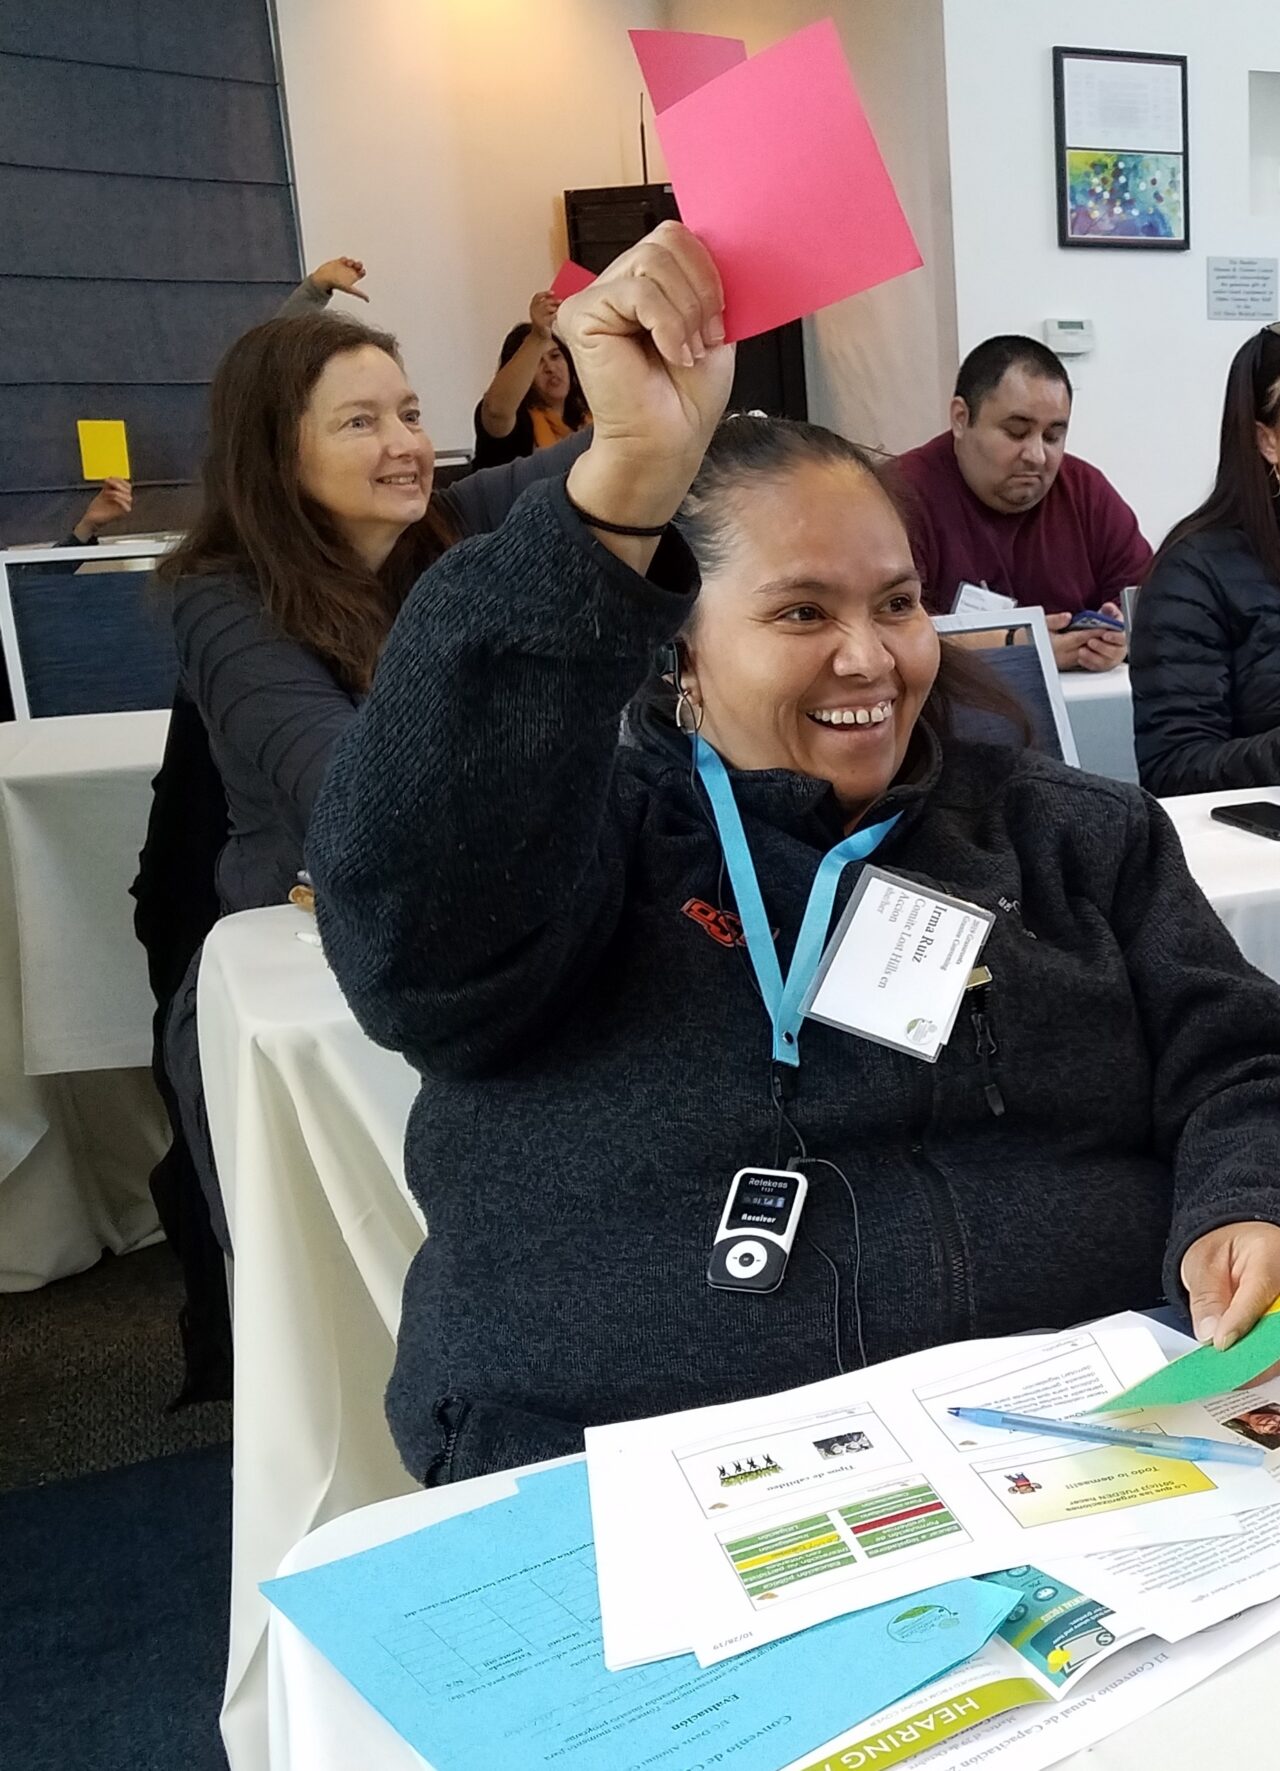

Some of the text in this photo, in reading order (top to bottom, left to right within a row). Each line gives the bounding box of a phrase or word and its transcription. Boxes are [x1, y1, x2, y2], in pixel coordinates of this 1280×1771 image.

[894, 930, 911, 952] Lost
[911, 904, 947, 965] Irma Ruiz
[883, 952, 901, 977] Hills
[741, 1213, 776, 1223] Receiver
[826, 1463, 856, 1476] Tipos
[1130, 1465, 1159, 1476] Todo
[1097, 1487, 1139, 1500] PUEDEN
[1154, 1485, 1172, 1493] que
[1065, 1493, 1136, 1512] organizaciones
[1069, 1496, 1096, 1505] hacer
[711, 1629, 753, 1652] 10/28/19
[1151, 1650, 1169, 1666] El
[1095, 1659, 1157, 1699] Convenio
[670, 1691, 740, 1734] Evaluación
[1059, 1693, 1098, 1720] Anual
[712, 1717, 730, 1731] UC
[1041, 1712, 1060, 1728] de
[680, 1727, 711, 1748] Davis
[704, 1712, 793, 1767] Convenio de
[837, 1693, 980, 1771] HEARING
[959, 1736, 973, 1747] 29
[946, 1743, 959, 1754] de
[958, 1718, 1044, 1771] Capacitación
